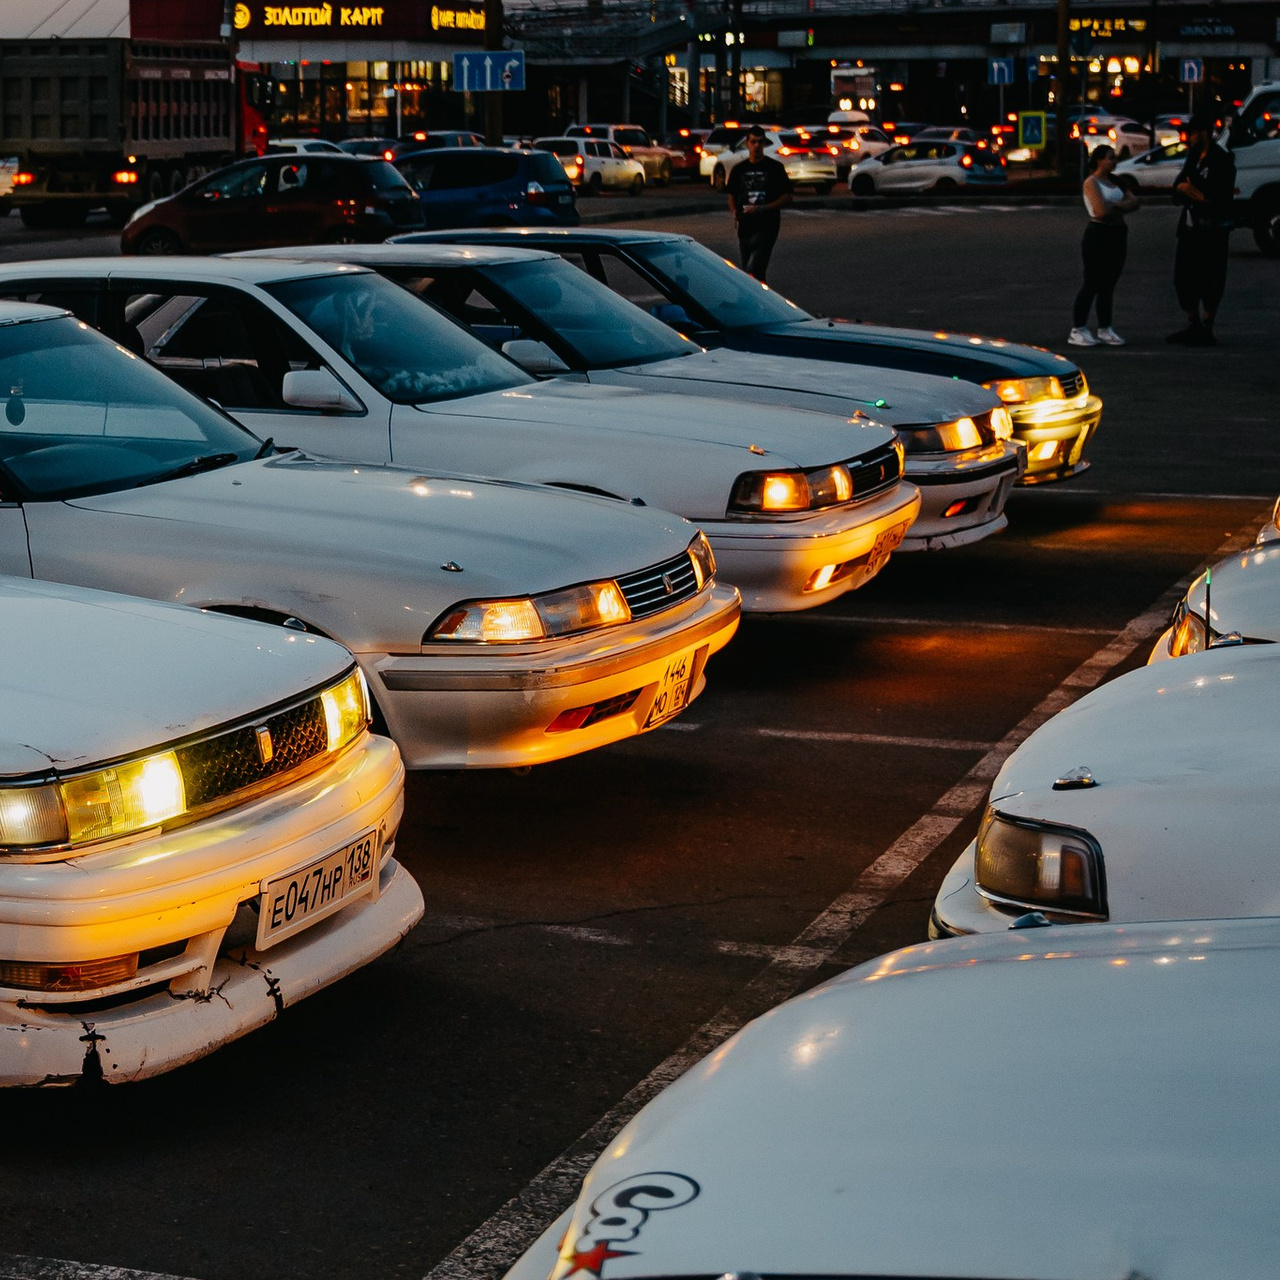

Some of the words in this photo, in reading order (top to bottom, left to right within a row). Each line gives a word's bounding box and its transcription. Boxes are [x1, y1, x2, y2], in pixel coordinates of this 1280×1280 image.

[264, 2, 332, 26] ЗОЛОТОЙ
[340, 6, 384, 26] КАРП
[347, 839, 371, 879] 138
[348, 874, 361, 888] RUS
